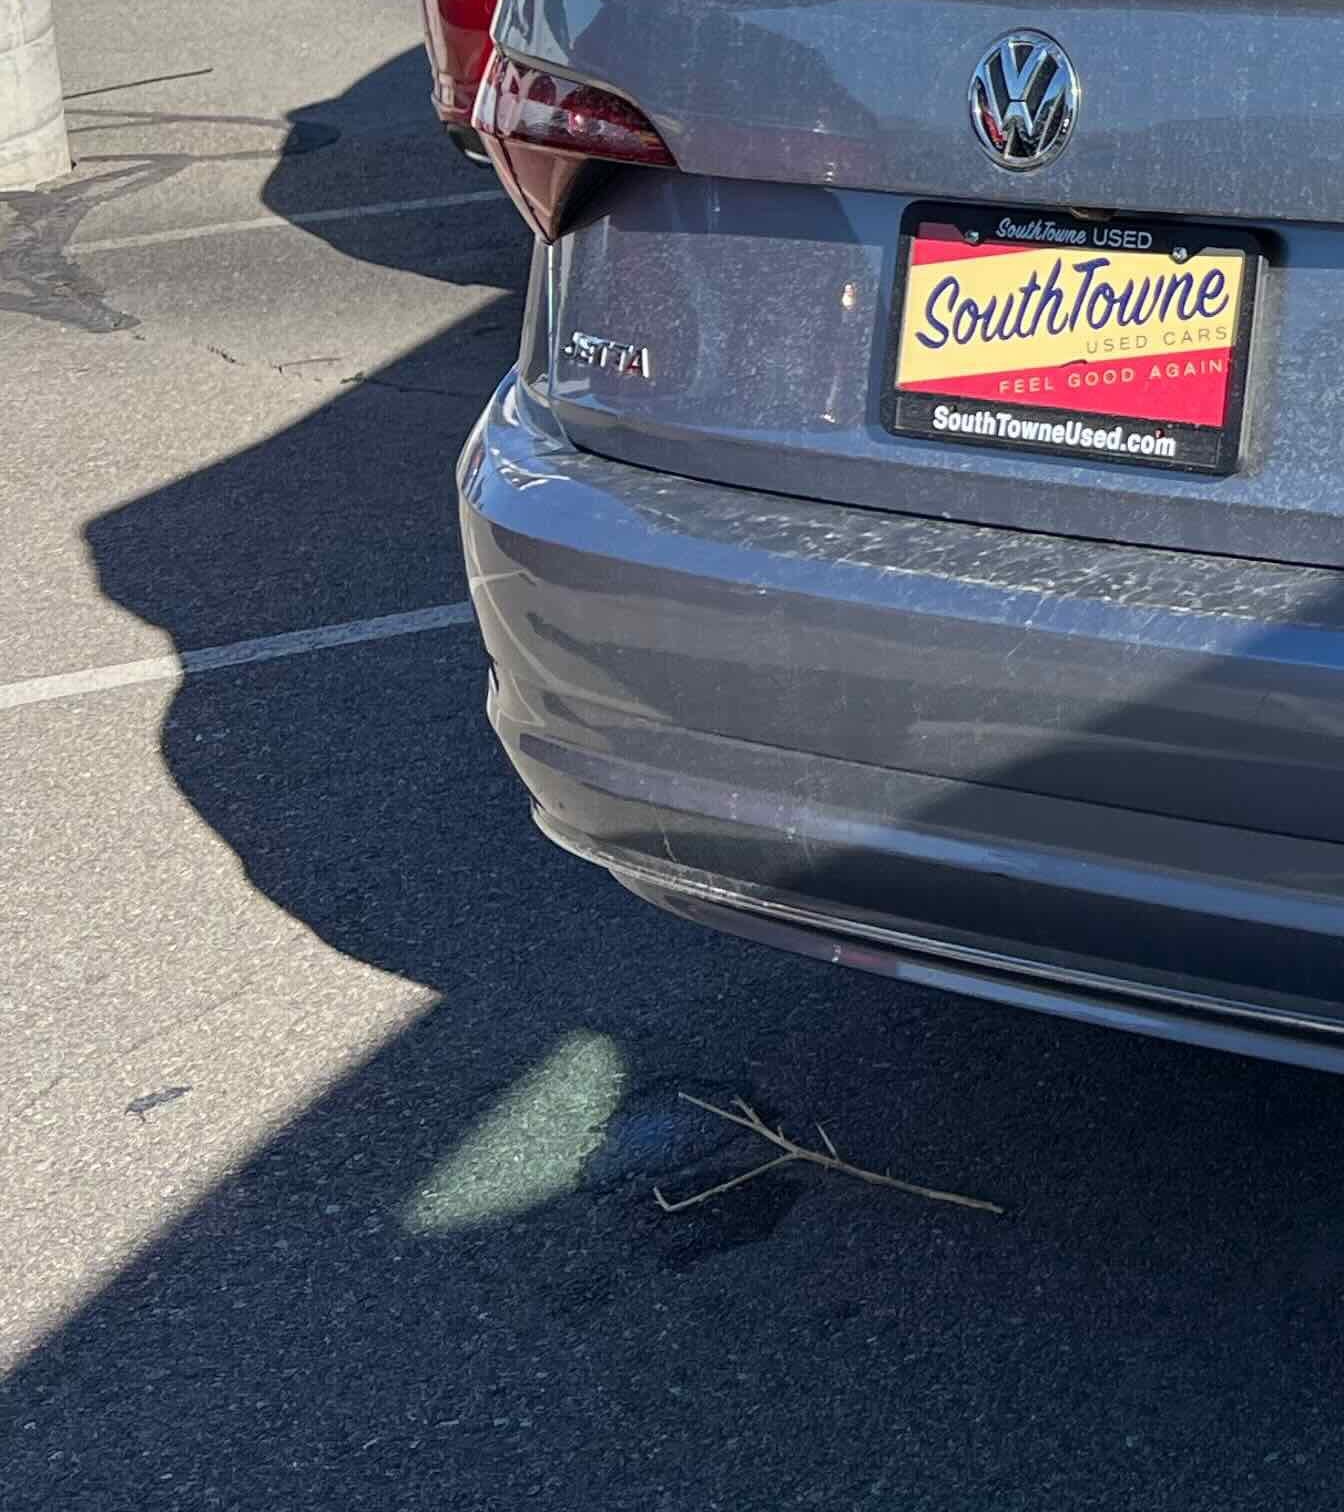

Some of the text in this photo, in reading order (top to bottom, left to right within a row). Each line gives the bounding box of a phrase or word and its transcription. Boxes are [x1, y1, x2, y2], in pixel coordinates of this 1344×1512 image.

[996, 218, 1152, 249] SouthTowne USED
[915, 257, 1229, 348] SouthTowne
[1085, 326, 1228, 355] USED CARS
[998, 359, 1225, 395] FEEL GOOD AGAIN
[933, 405, 1176, 457] SouthTowneUsed.com
